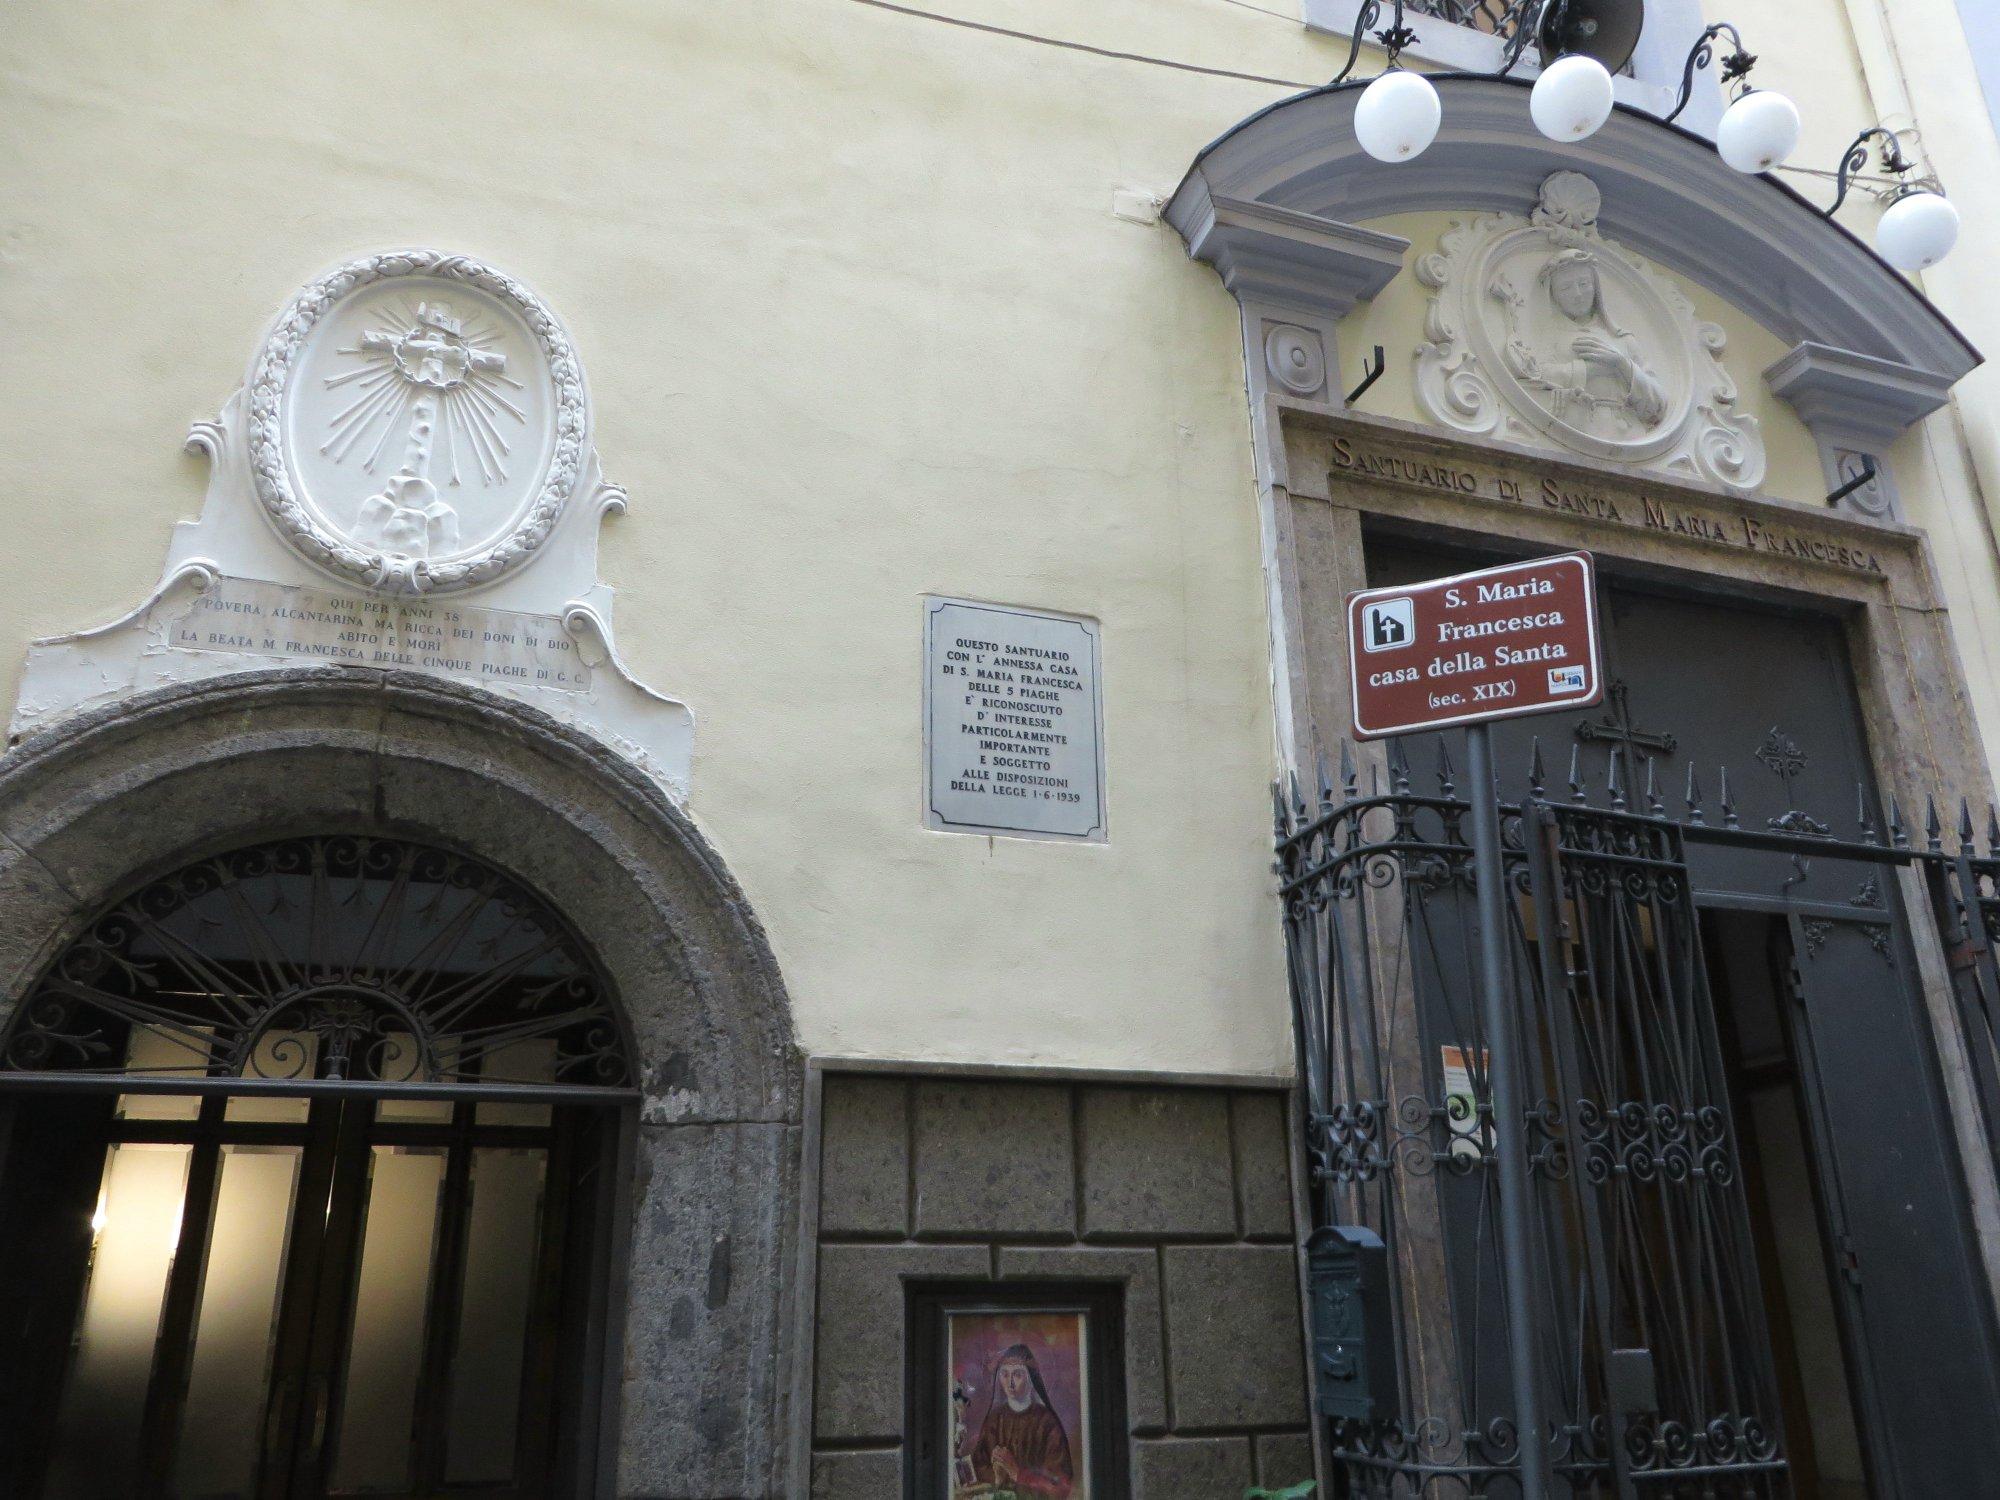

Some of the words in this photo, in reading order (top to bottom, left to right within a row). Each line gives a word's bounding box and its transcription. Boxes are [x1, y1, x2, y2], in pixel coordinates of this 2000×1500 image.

[1498, 479, 1522, 501] DI
[1445, 588, 1468, 608] S.
[1477, 577, 1554, 604] Maria
[330, 598, 354, 610] QUI
[364, 602, 388, 613] PER
[400, 607, 433, 619] ANNI
[205, 599, 261, 615] POVERA
[272, 608, 364, 627] ALCANTARINA
[375, 620, 394, 630] MA
[405, 622, 442, 636] RICCA
[453, 629, 473, 640] DEI
[484, 632, 515, 644] DONI
[526, 637, 538, 647] DI
[548, 640, 569, 650] DIO
[1437, 609, 1564, 642] Francesca
[337, 631, 378, 644] ABITO
[388, 636, 396, 646] E
[181, 630, 198, 641] LA
[208, 633, 253, 647] BEATA
[286, 641, 364, 659] FRANCESCA
[374, 651, 414, 665] DELLE
[423, 656, 472, 671] CINQUE
[482, 664, 527, 677] PIAGHE
[537, 670, 548, 680] DI
[956, 638, 999, 652] QUESTO
[1005, 644, 1070, 661] SANTUARIO
[947, 651, 970, 662] CON
[993, 657, 1043, 672] ANNESSA
[1050, 664, 1078, 676] CASA
[1369, 667, 1420, 687] casa
[1427, 652, 1487, 678] della
[1495, 642, 1568, 666] Santa
[943, 665, 954, 674] DI
[961, 667, 970, 676] S.
[977, 669, 1014, 682] MARIA
[1021, 675, 1083, 691] FRANCESCA
[968, 682, 1000, 694] DELLE
[1007, 686, 1014, 695] 5
[1020, 688, 1060, 701] PIAGHE
[1428, 692, 1466, 710] (sec.
[1472, 679, 1516, 702] XIX)
[982, 698, 1063, 716] RICONOSCIUTO
[995, 713, 1052, 729] INTERESSE
[961, 724, 1068, 745] PARTICOLARMENTE
[980, 740, 1050, 756] IMPORTANTE
[980, 755, 987, 764] E
[993, 756, 1051, 771] SOGGETTO
[951, 780, 986, 793] DELLA
[993, 785, 1027, 798] LEGGE
[962, 769, 990, 780] ALLE
[996, 772, 1068, 788] DISPOSIZIONI
